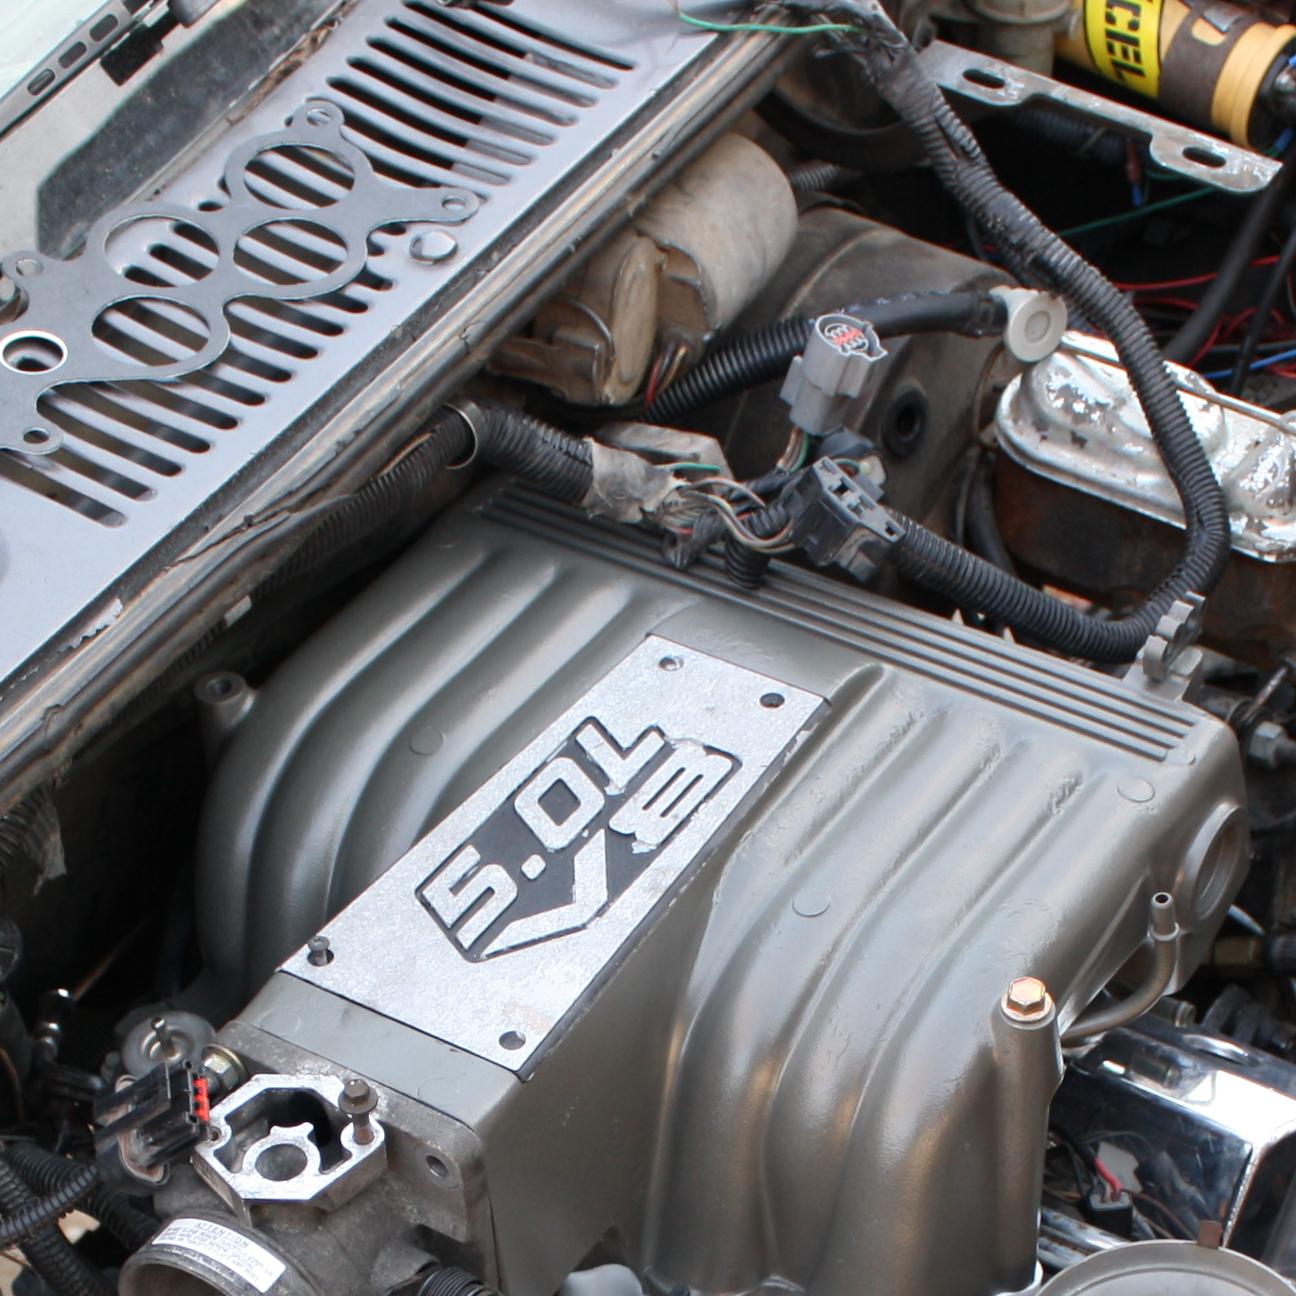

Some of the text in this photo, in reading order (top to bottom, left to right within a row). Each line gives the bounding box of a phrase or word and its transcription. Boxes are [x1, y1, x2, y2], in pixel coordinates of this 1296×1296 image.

[418, 720, 666, 952] 5.0L
[482, 740, 735, 960] V8
[194, 1222, 249, 1249] ATTENTION
